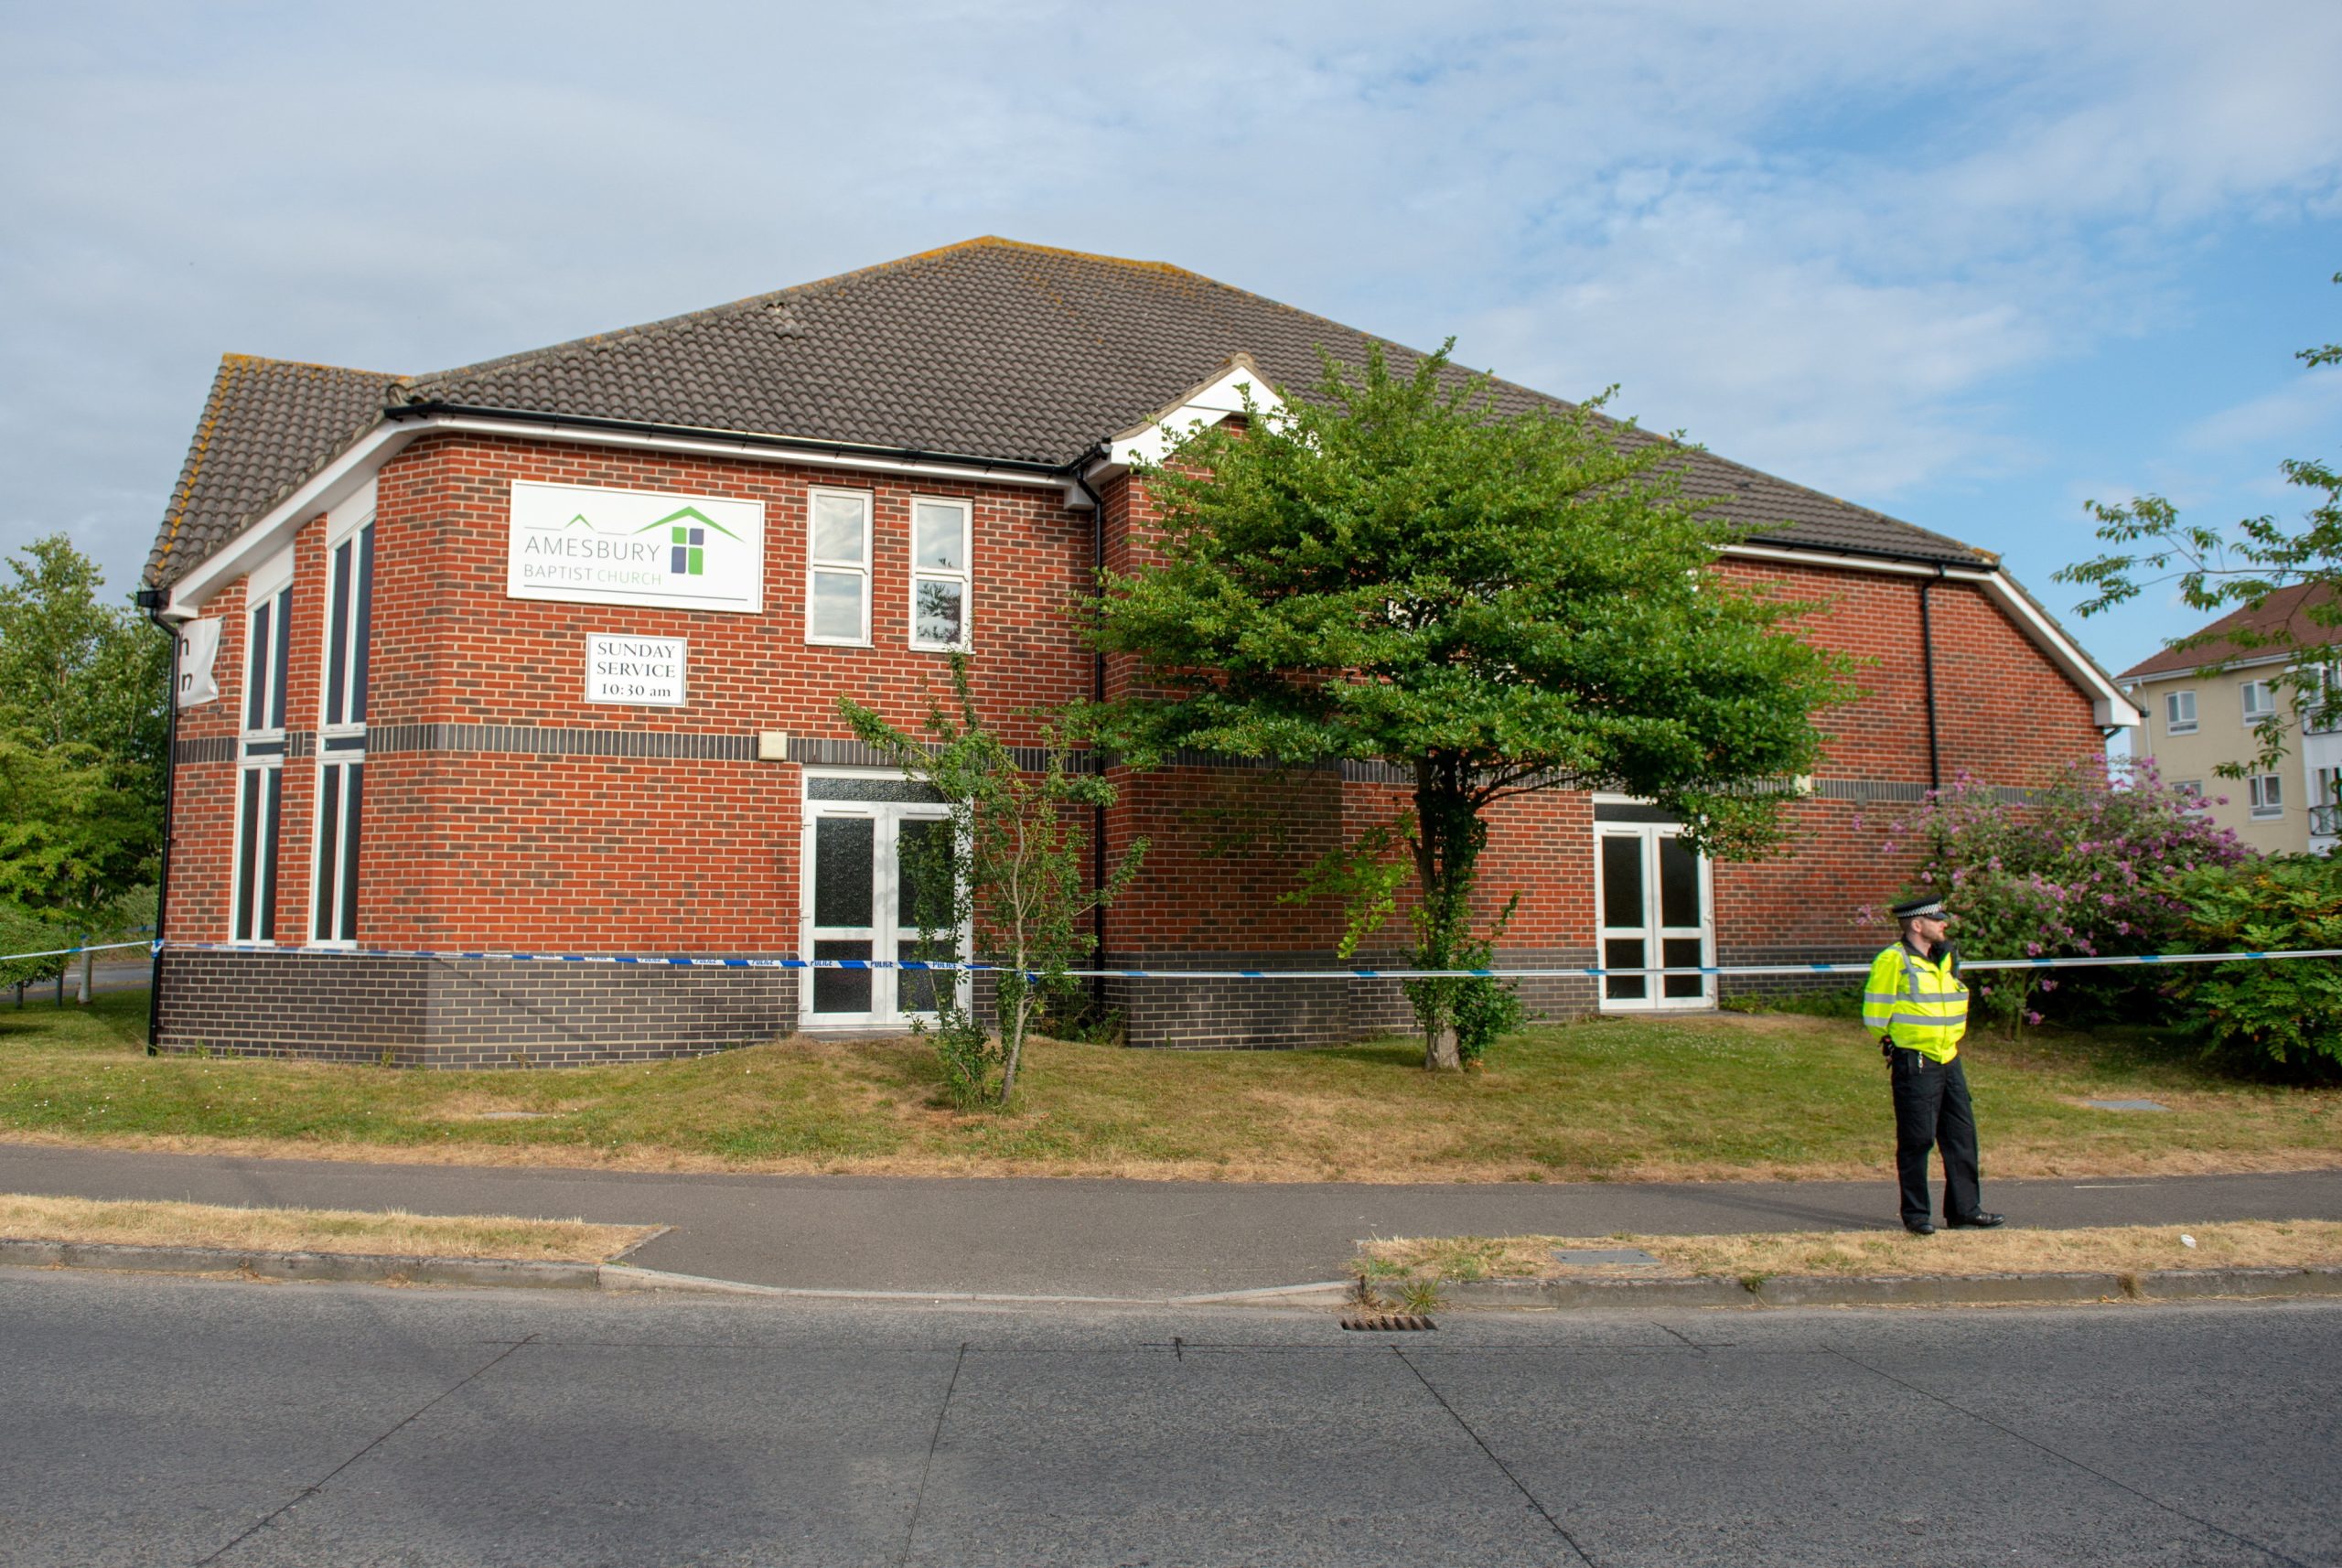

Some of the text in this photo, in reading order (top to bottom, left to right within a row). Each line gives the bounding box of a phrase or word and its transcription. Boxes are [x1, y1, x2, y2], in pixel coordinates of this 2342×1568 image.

[524, 535, 661, 563] AMESBURY
[524, 564, 661, 585] BAPTIST CHURCH
[597, 641, 675, 659] SUNDAY
[596, 660, 675, 678] SERVICE
[602, 683, 671, 697] 10:30 am
[932, 961, 956, 969] POLICE
